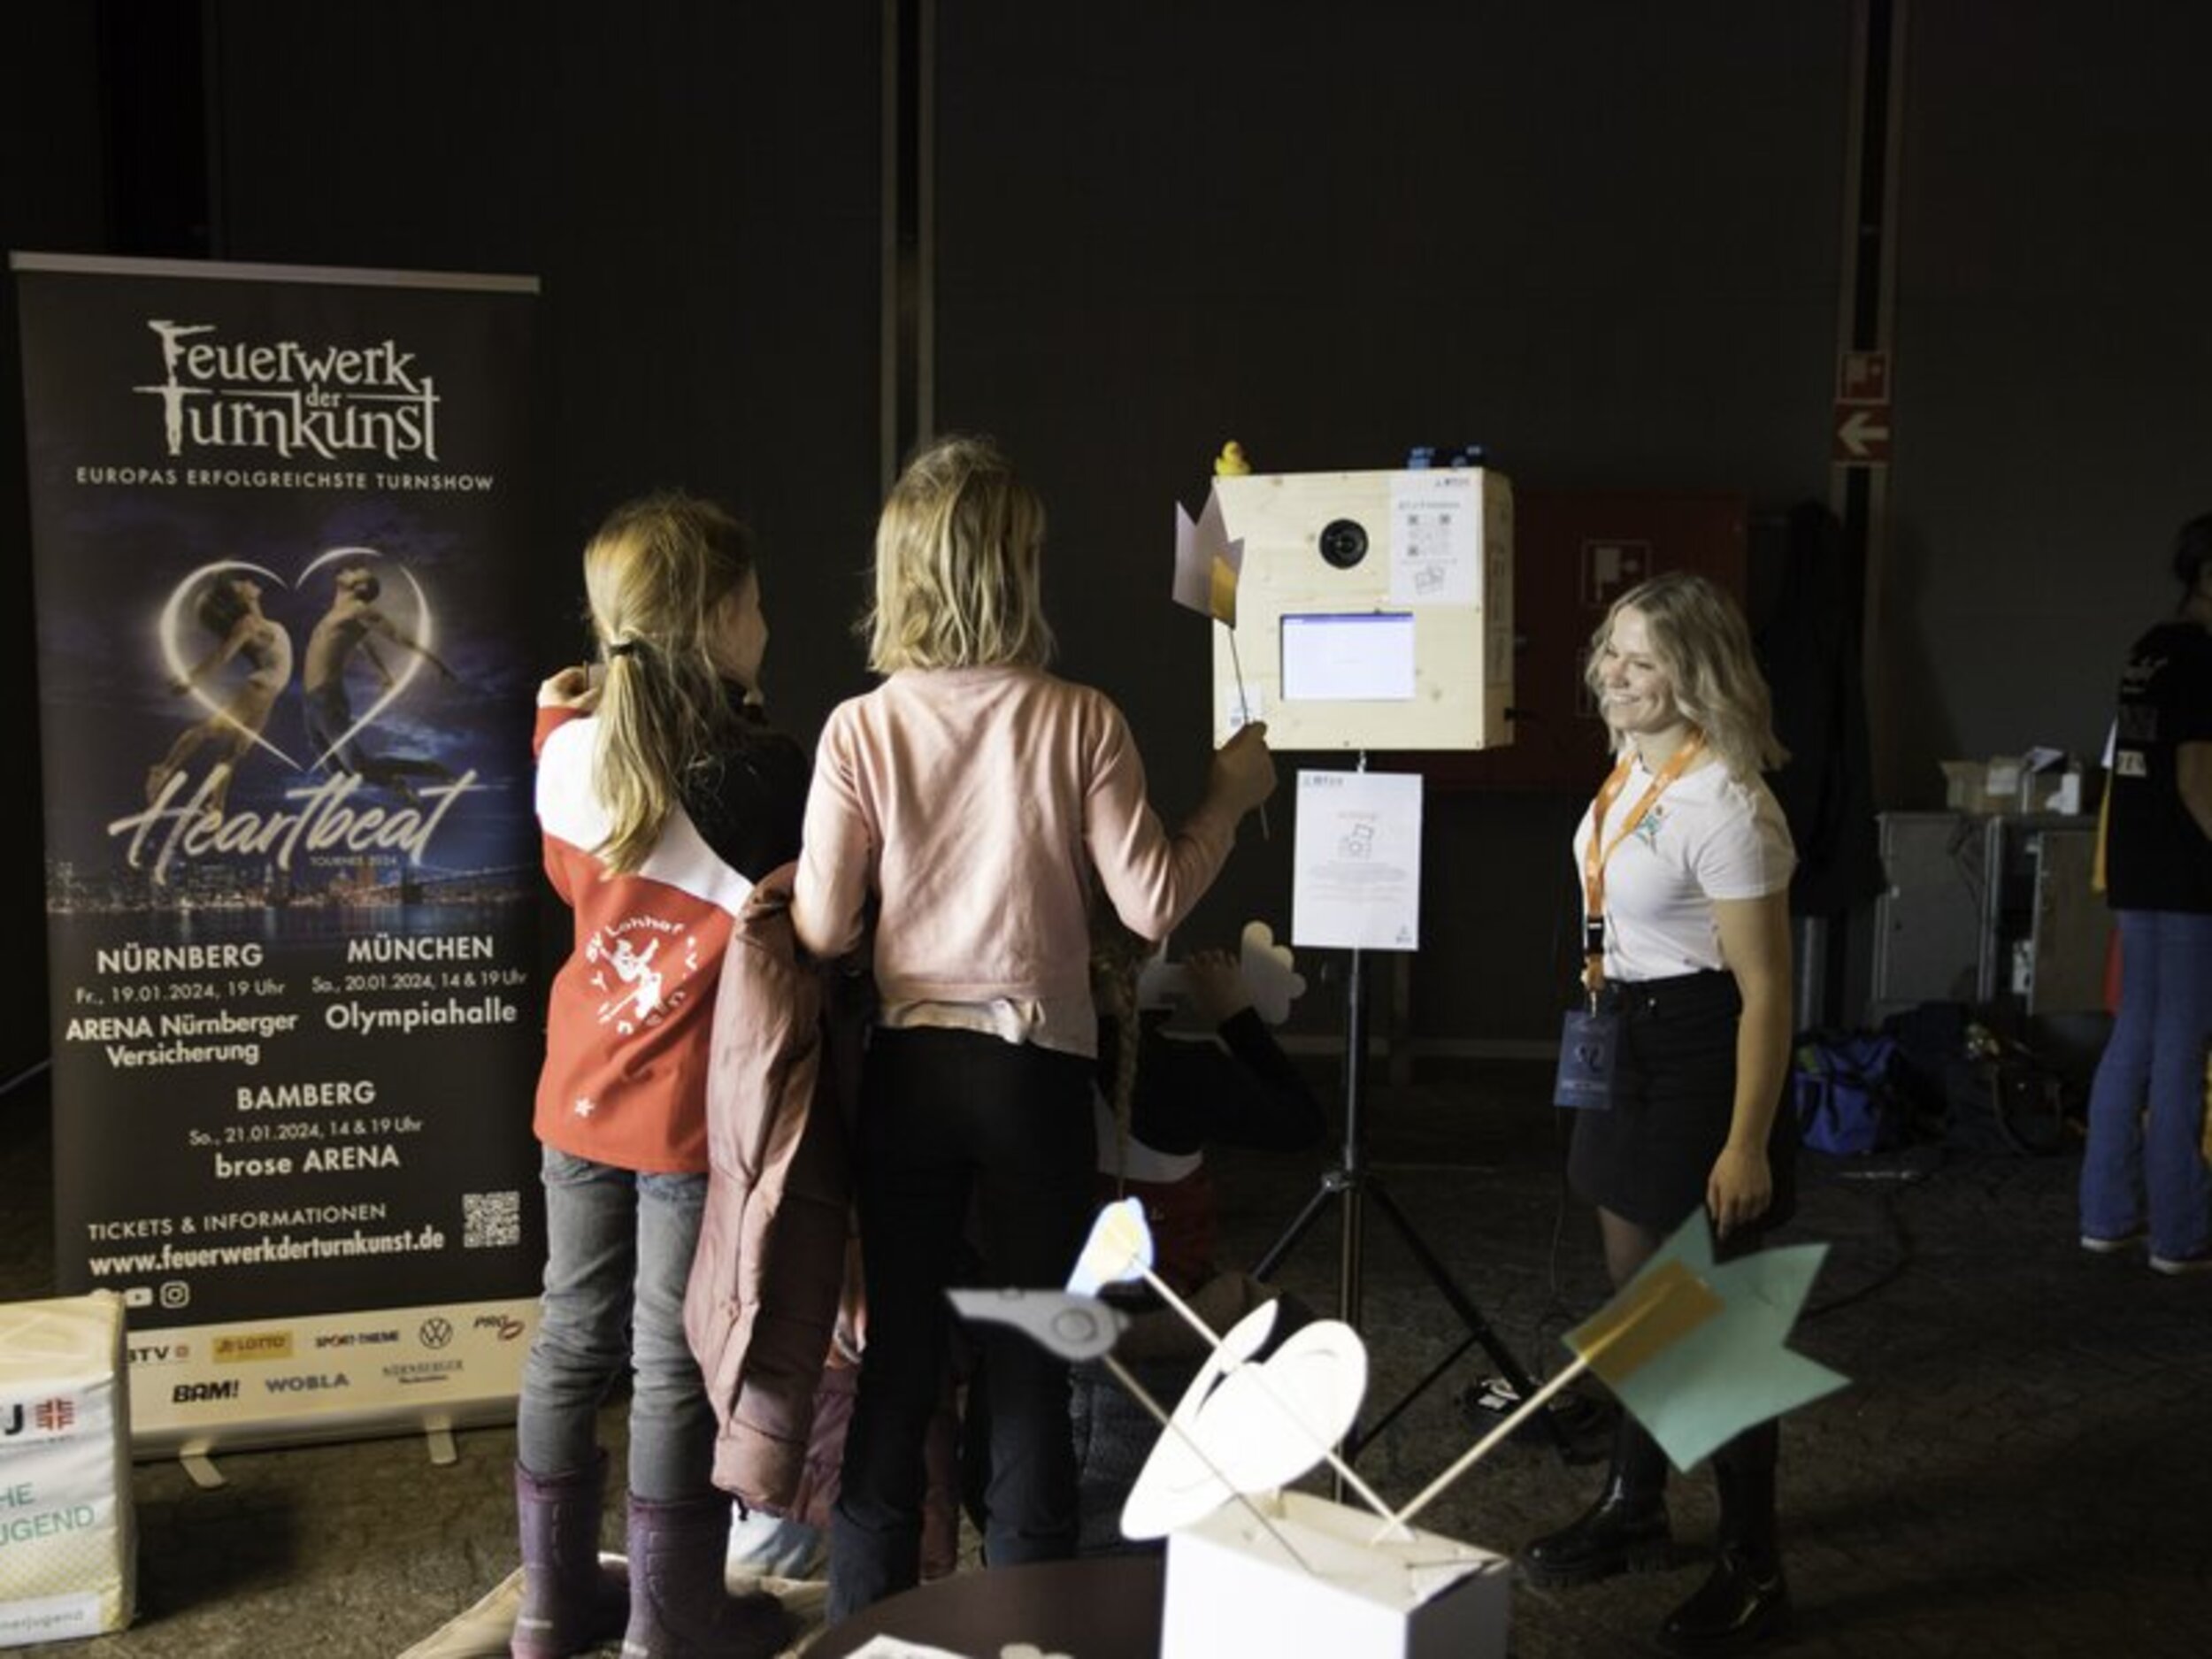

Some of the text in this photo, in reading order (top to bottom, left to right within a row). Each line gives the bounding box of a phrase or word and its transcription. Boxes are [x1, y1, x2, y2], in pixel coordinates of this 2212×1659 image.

[148, 319, 419, 394] Feuerwerk
[305, 384, 341, 409] der
[133, 376, 440, 461] Turnkunst
[76, 466, 494, 491] EUROPAS ERFOLGREICHSTE TURNSHOW
[108, 763, 477, 885] Heartbeat
[96, 941, 265, 974] NÜRNBERG
[347, 933, 494, 964] MÜNCHEN
[111, 982, 221, 1003] 19.01.2024,
[227, 980, 251, 998] 19
[256, 978, 285, 997] Uhr
[345, 973, 435, 993] 20.01.2024,
[441, 973, 460, 989] 14
[464, 972, 476, 987] &
[482, 972, 500, 987] 19
[65, 1010, 299, 1041] ARENA Nürnberger
[325, 998, 518, 1033] Olympiahalle
[106, 1043, 259, 1068] Versicherung
[236, 1080, 377, 1111] BAMBERG
[225, 1122, 325, 1144] 21.01.2024,
[328, 1120, 350, 1139] 14
[354, 1119, 367, 1136] &
[373, 1118, 392, 1136] 19
[394, 1117, 424, 1133] Uhr
[214, 1146, 400, 1179] brose ARENA
[88, 1202, 387, 1241] TICKETS & INFORMATIONEN
[89, 1228, 444, 1278] www.feuerwerkderturnkunst.de
[173, 1380, 239, 1404] BAM!
[265, 1372, 349, 1394] WOBLA
